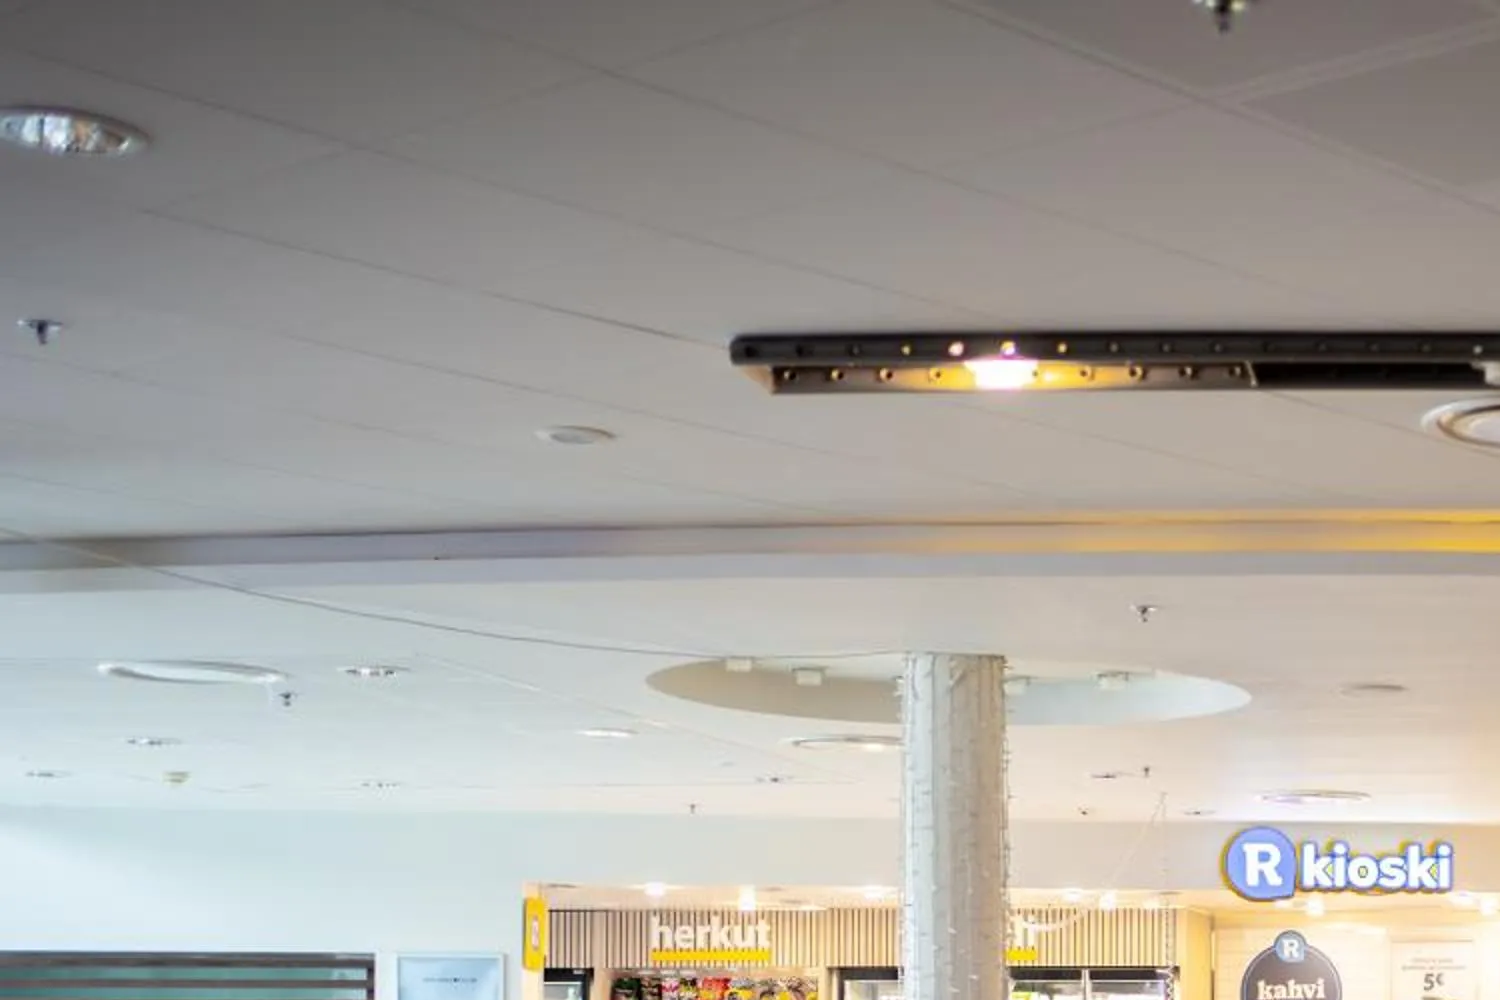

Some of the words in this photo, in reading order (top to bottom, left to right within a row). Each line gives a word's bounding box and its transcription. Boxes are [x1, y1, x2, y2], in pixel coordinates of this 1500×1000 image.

[1242, 843, 1283, 887] R
[1302, 842, 1452, 889] kioski
[652, 913, 771, 949] herkut
[1282, 939, 1300, 959] R
[1256, 977, 1326, 1000] kahvi
